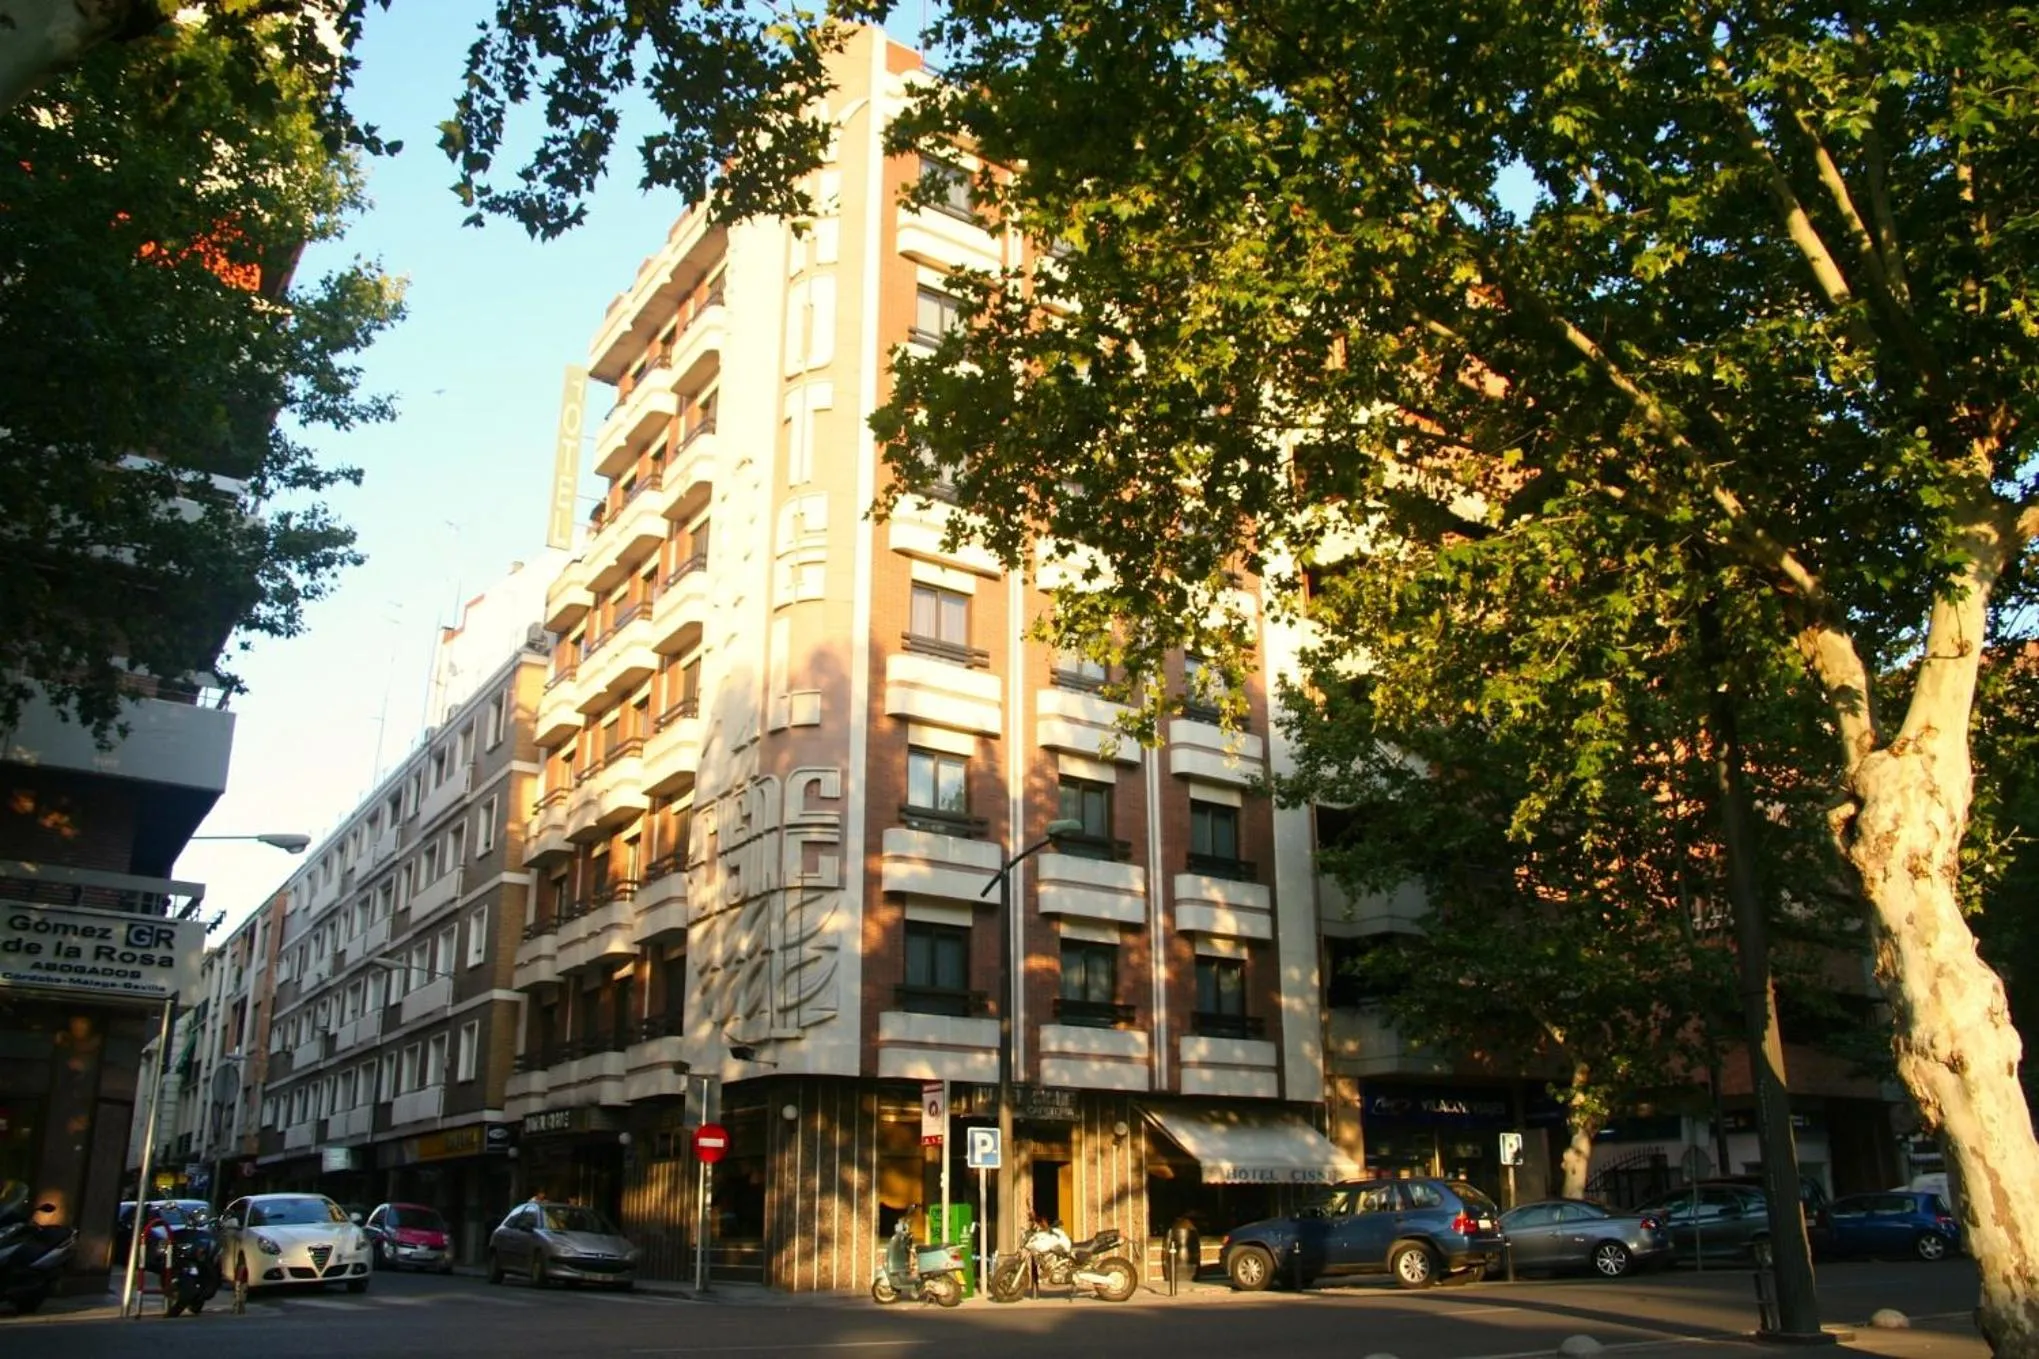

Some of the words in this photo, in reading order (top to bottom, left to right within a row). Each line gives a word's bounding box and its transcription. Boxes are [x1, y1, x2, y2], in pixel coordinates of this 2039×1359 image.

[8, 914, 112, 940] Gómez
[126, 923, 175, 949] GR
[2, 938, 42, 955] de
[54, 941, 82, 959] la
[94, 945, 175, 968] Rosa
[30, 961, 141, 980] ABOGADOS
[973, 1131, 995, 1164] P
[1226, 1167, 1278, 1181] HOTEL
